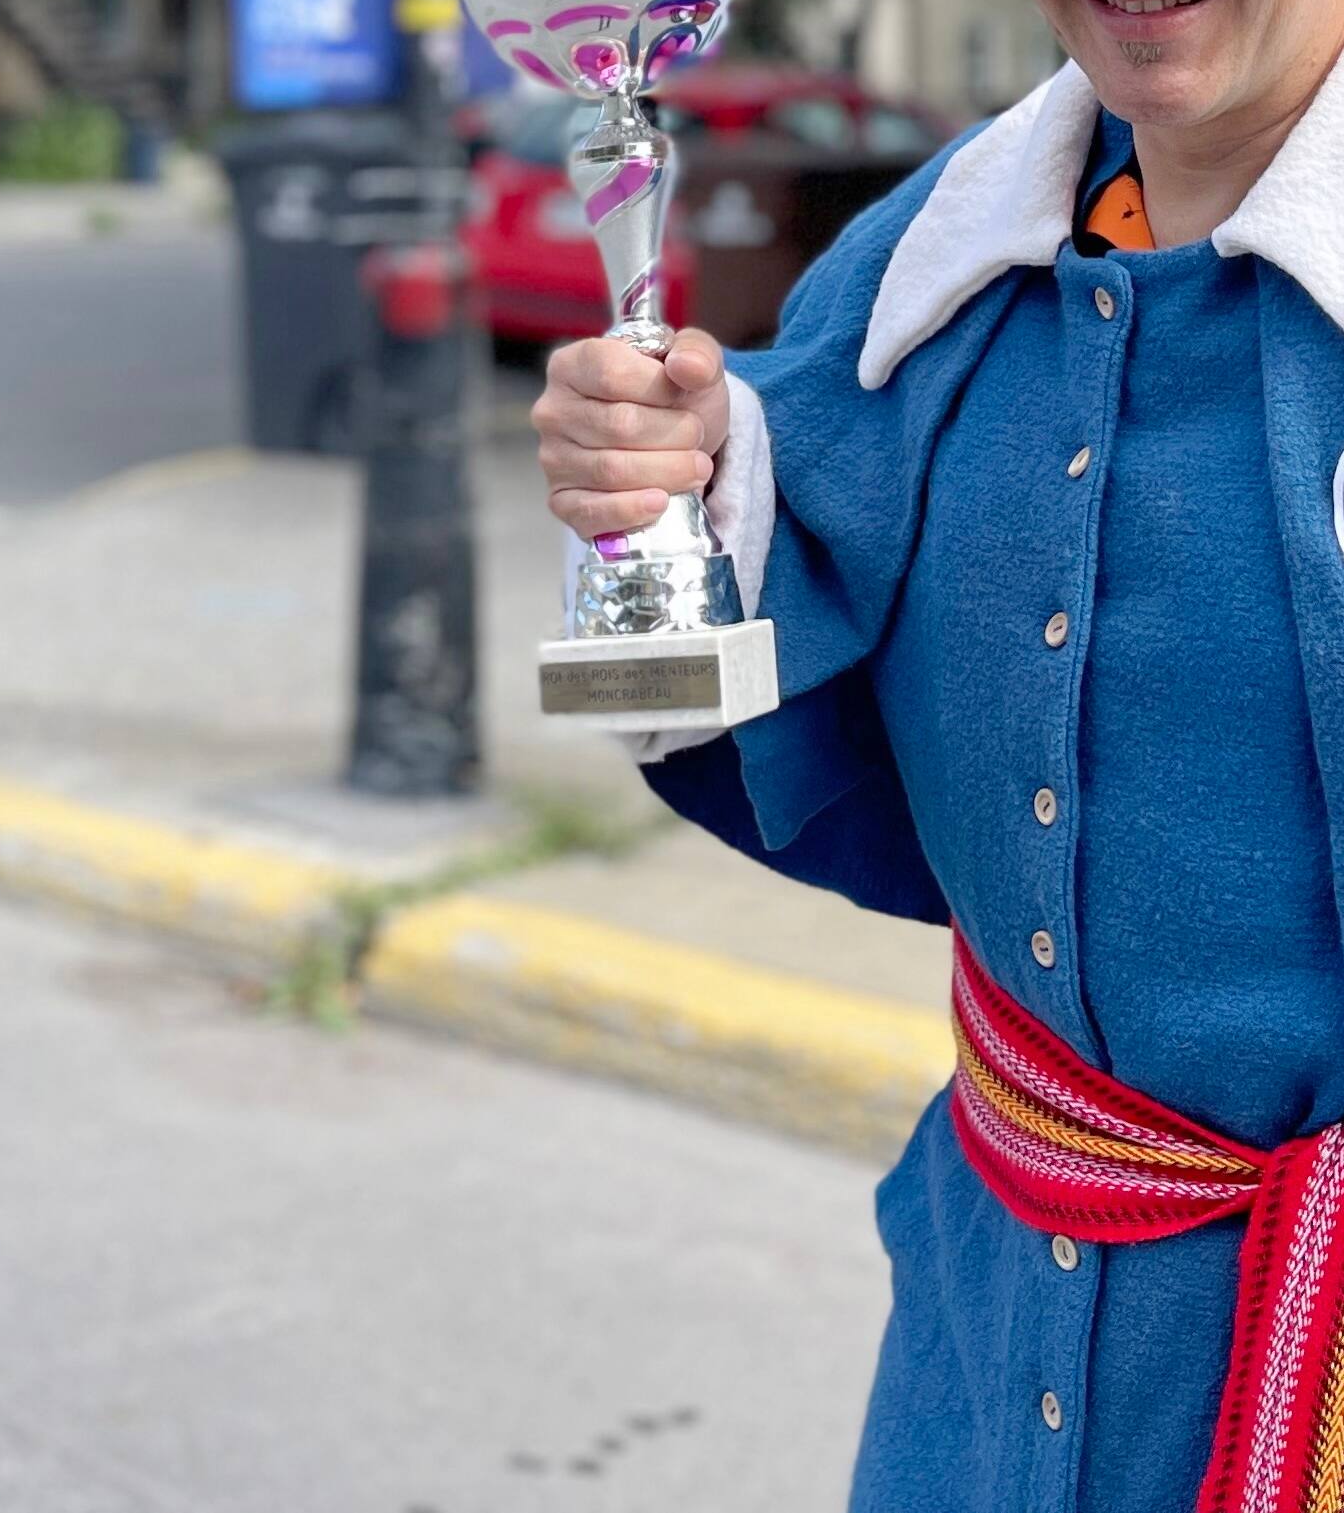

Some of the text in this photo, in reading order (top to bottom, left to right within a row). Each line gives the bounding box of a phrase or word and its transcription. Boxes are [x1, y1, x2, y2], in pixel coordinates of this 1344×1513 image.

[543, 671, 562, 686] ROI
[591, 668, 620, 682] ROIS
[624, 668, 645, 680] des
[649, 662, 716, 678] MENTEURS
[586, 687, 671, 702] MONCRABEAU
